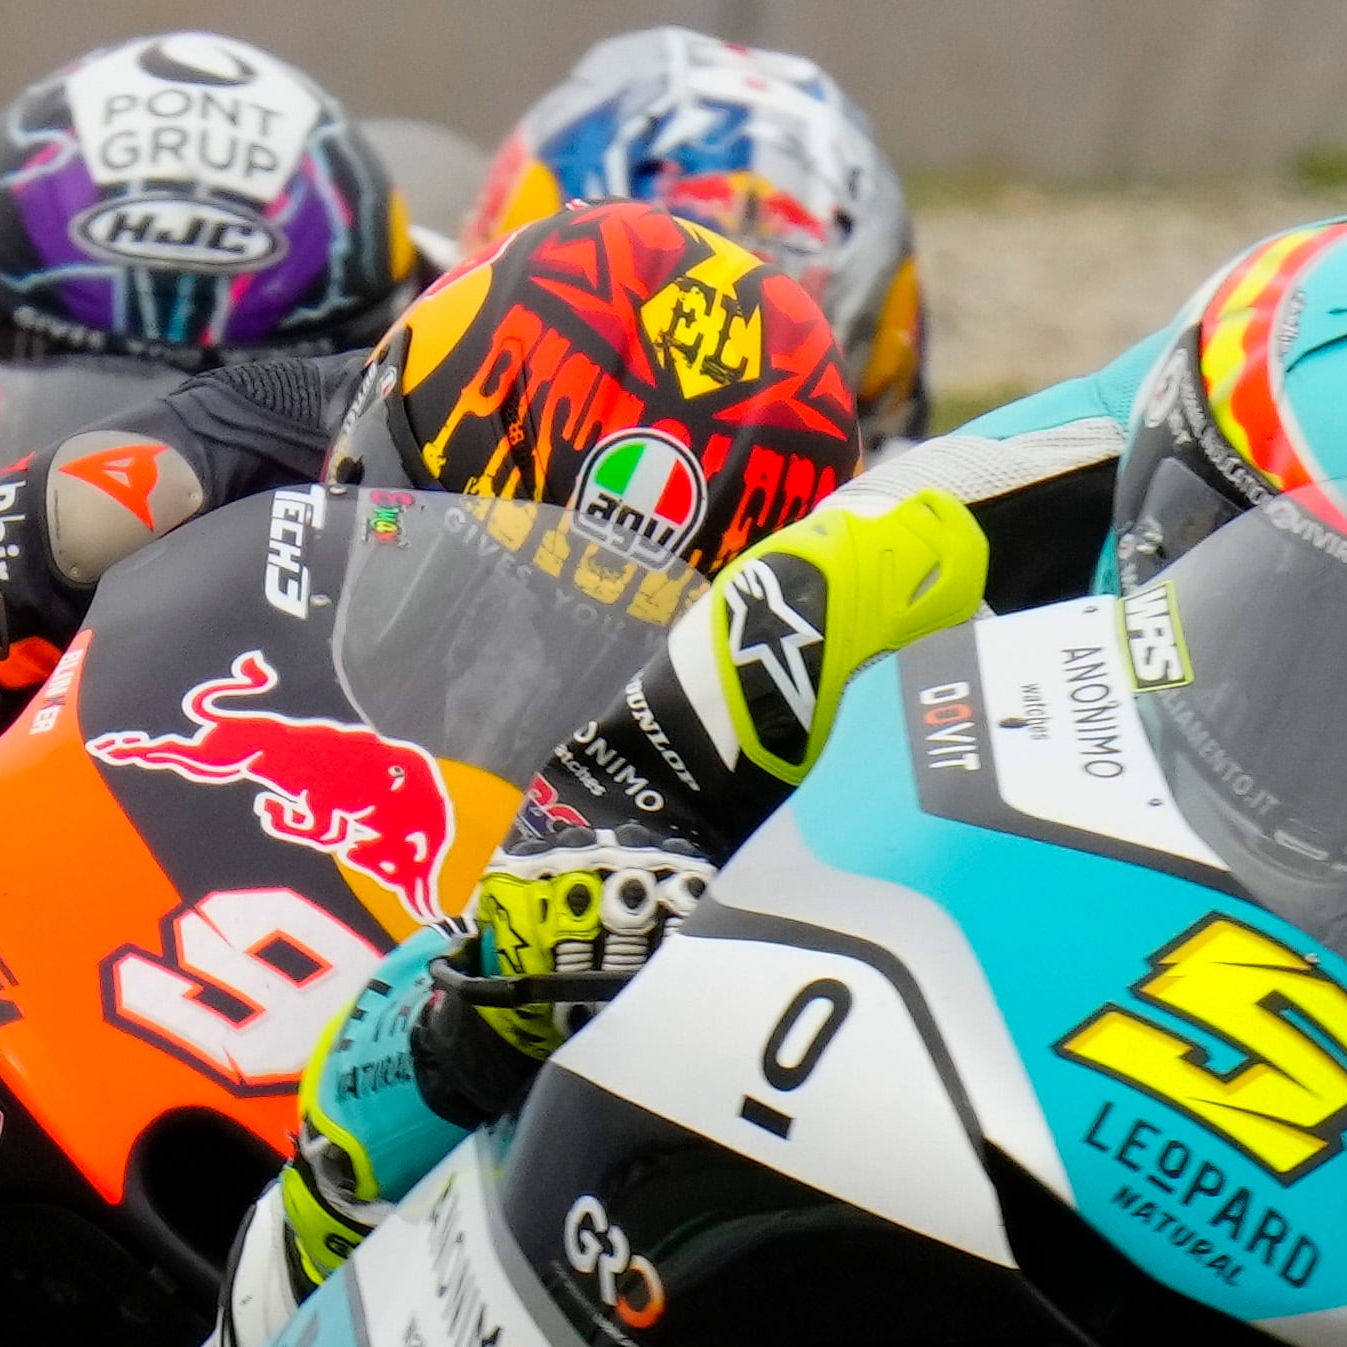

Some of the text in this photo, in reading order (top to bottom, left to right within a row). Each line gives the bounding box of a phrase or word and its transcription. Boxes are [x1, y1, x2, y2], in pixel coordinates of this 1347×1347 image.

[99, 126, 283, 181] GRUP
[104, 88, 285, 140] PONT
[106, 206, 253, 253] HJC
[266, 484, 325, 620] TECH3
[1121, 581, 1189, 686] WRS
[918, 680, 982, 774] DOVIT
[1059, 645, 1125, 781] ANONIMO
[1083, 1101, 1325, 1291] LEOPARD
[1111, 1183, 1245, 1290] NATURAL
